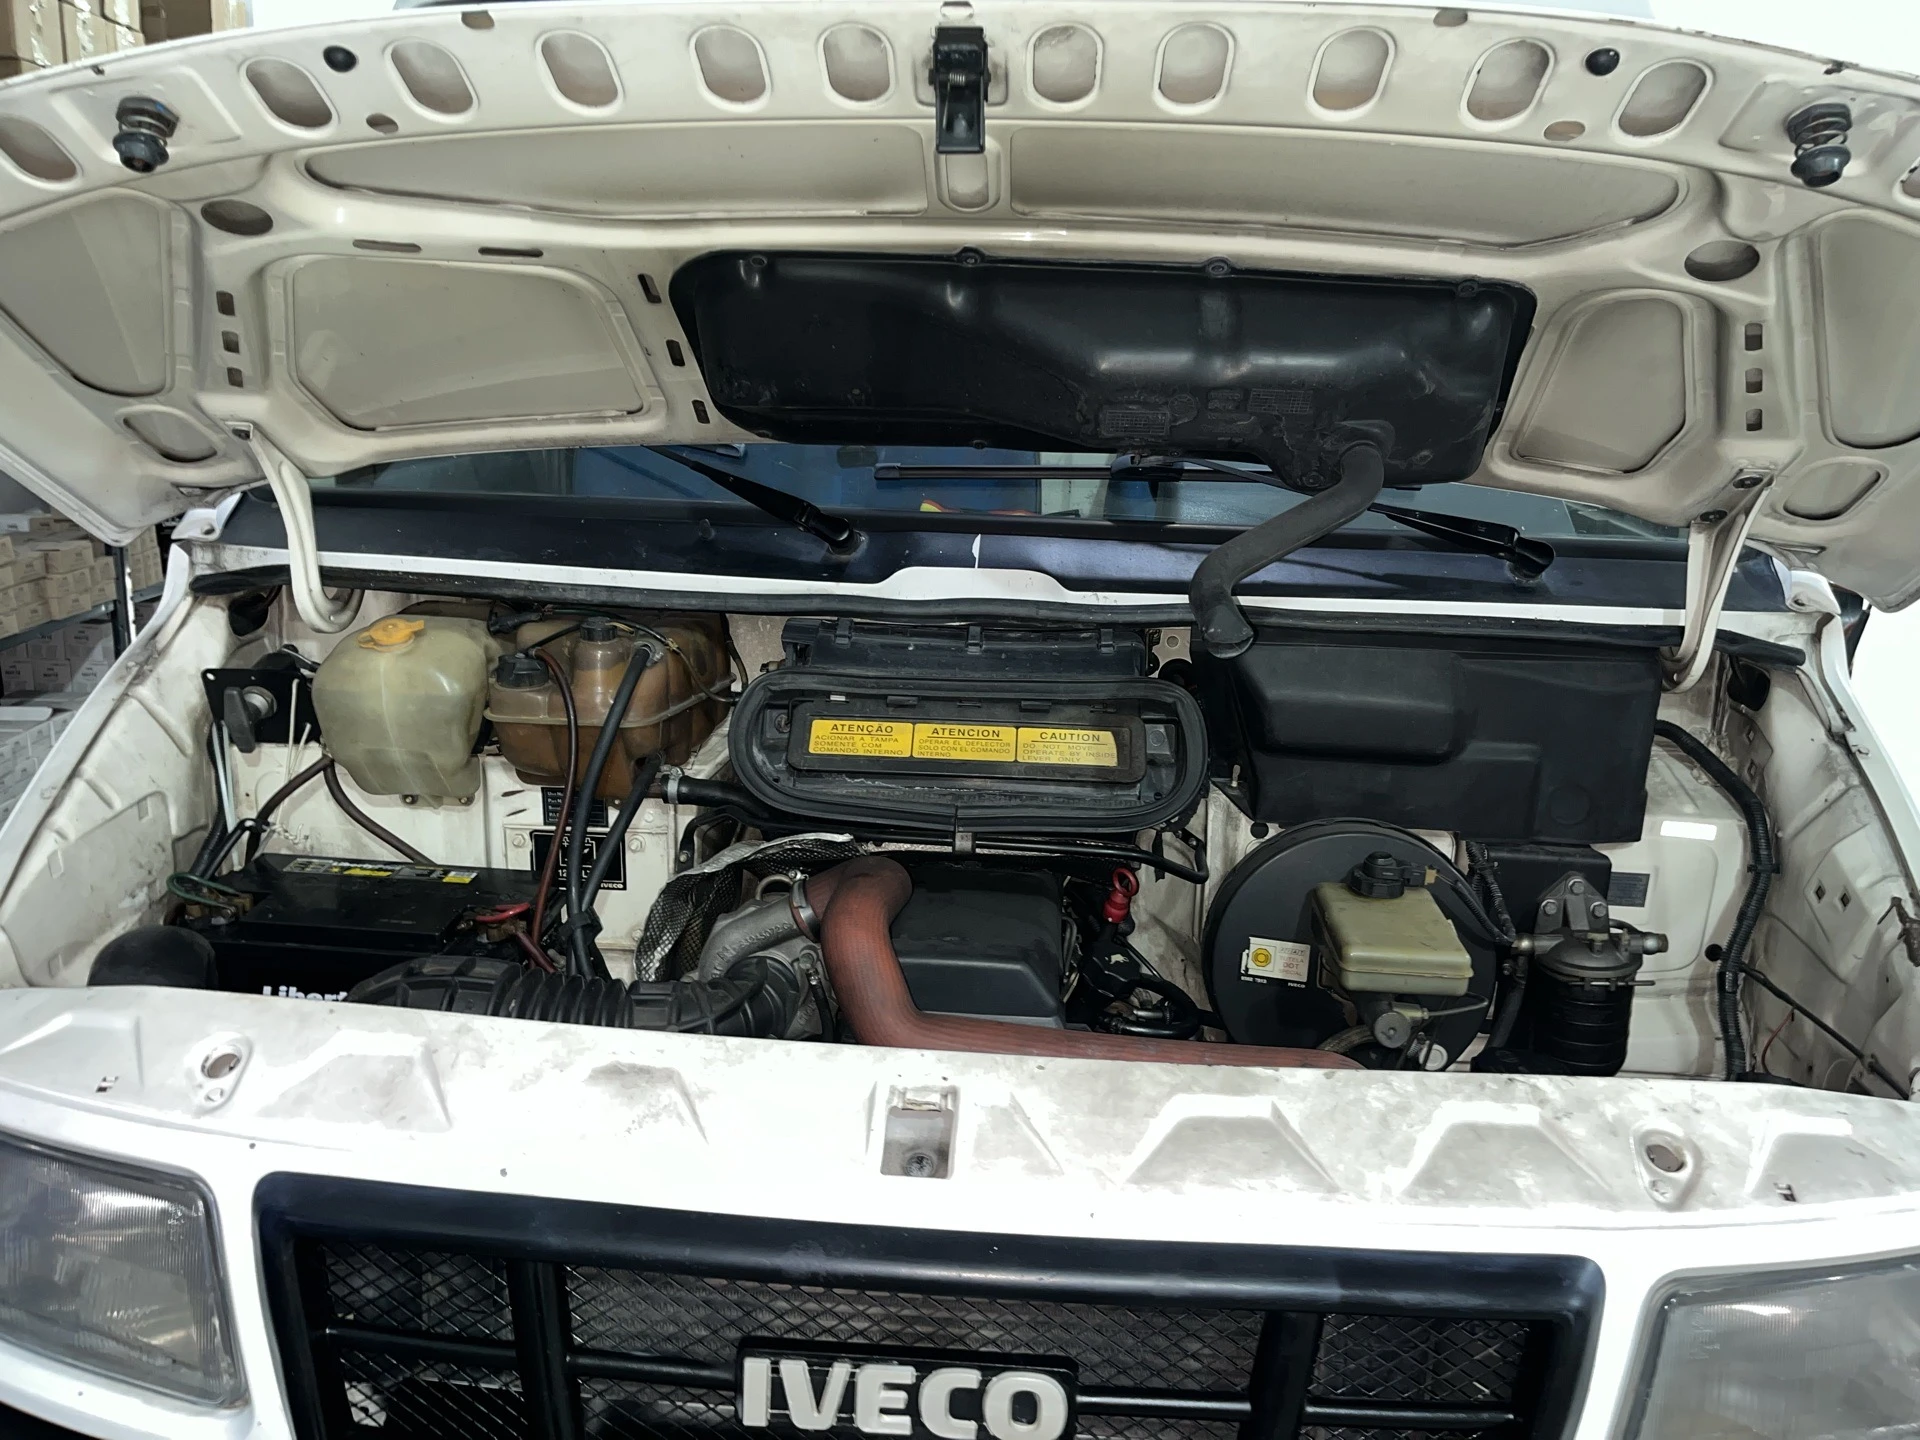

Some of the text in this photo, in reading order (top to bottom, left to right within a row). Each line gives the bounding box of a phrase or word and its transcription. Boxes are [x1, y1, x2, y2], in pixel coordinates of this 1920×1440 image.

[831, 724, 893, 735] ATENÇÃO
[931, 728, 1000, 738] ATENCION
[1039, 731, 1101, 742] CAUTION
[1283, 962, 1300, 970] DOT
[742, 1356, 1068, 1440] IVECO
